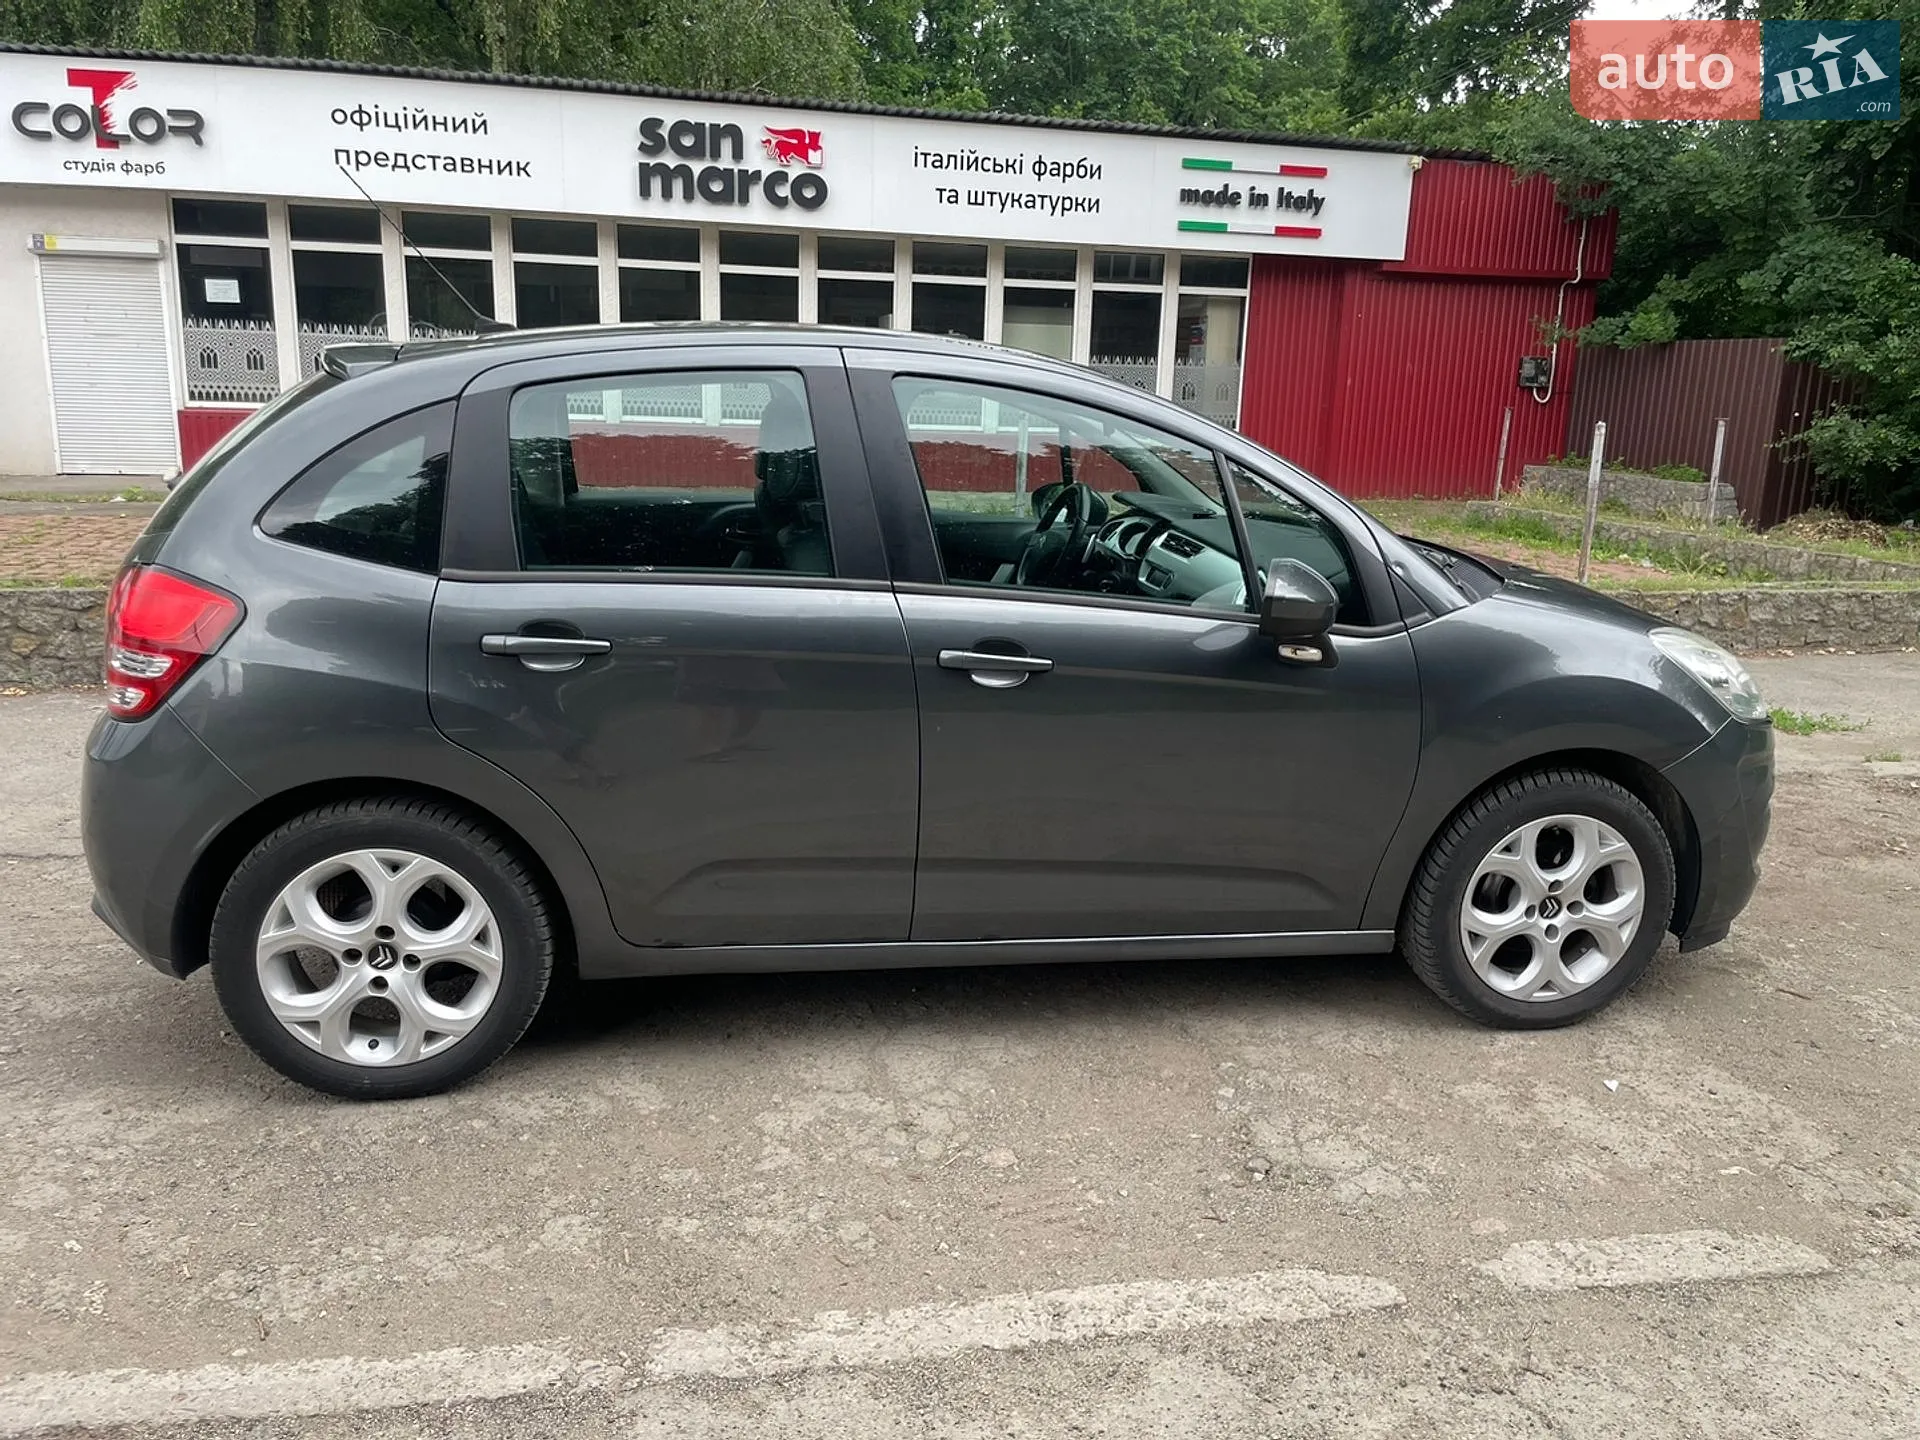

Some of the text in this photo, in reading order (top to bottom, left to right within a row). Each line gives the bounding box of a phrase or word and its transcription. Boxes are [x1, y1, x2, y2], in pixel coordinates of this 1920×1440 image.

[330, 103, 489, 136] офіційний
[637, 116, 744, 162] san
[63, 158, 166, 176] студія фарб
[333, 148, 532, 178] представник
[913, 145, 1103, 183] італійські фарби
[637, 161, 829, 211] marco
[935, 187, 1101, 217] та штукатурки
[1179, 182, 1326, 217] made in Italy
